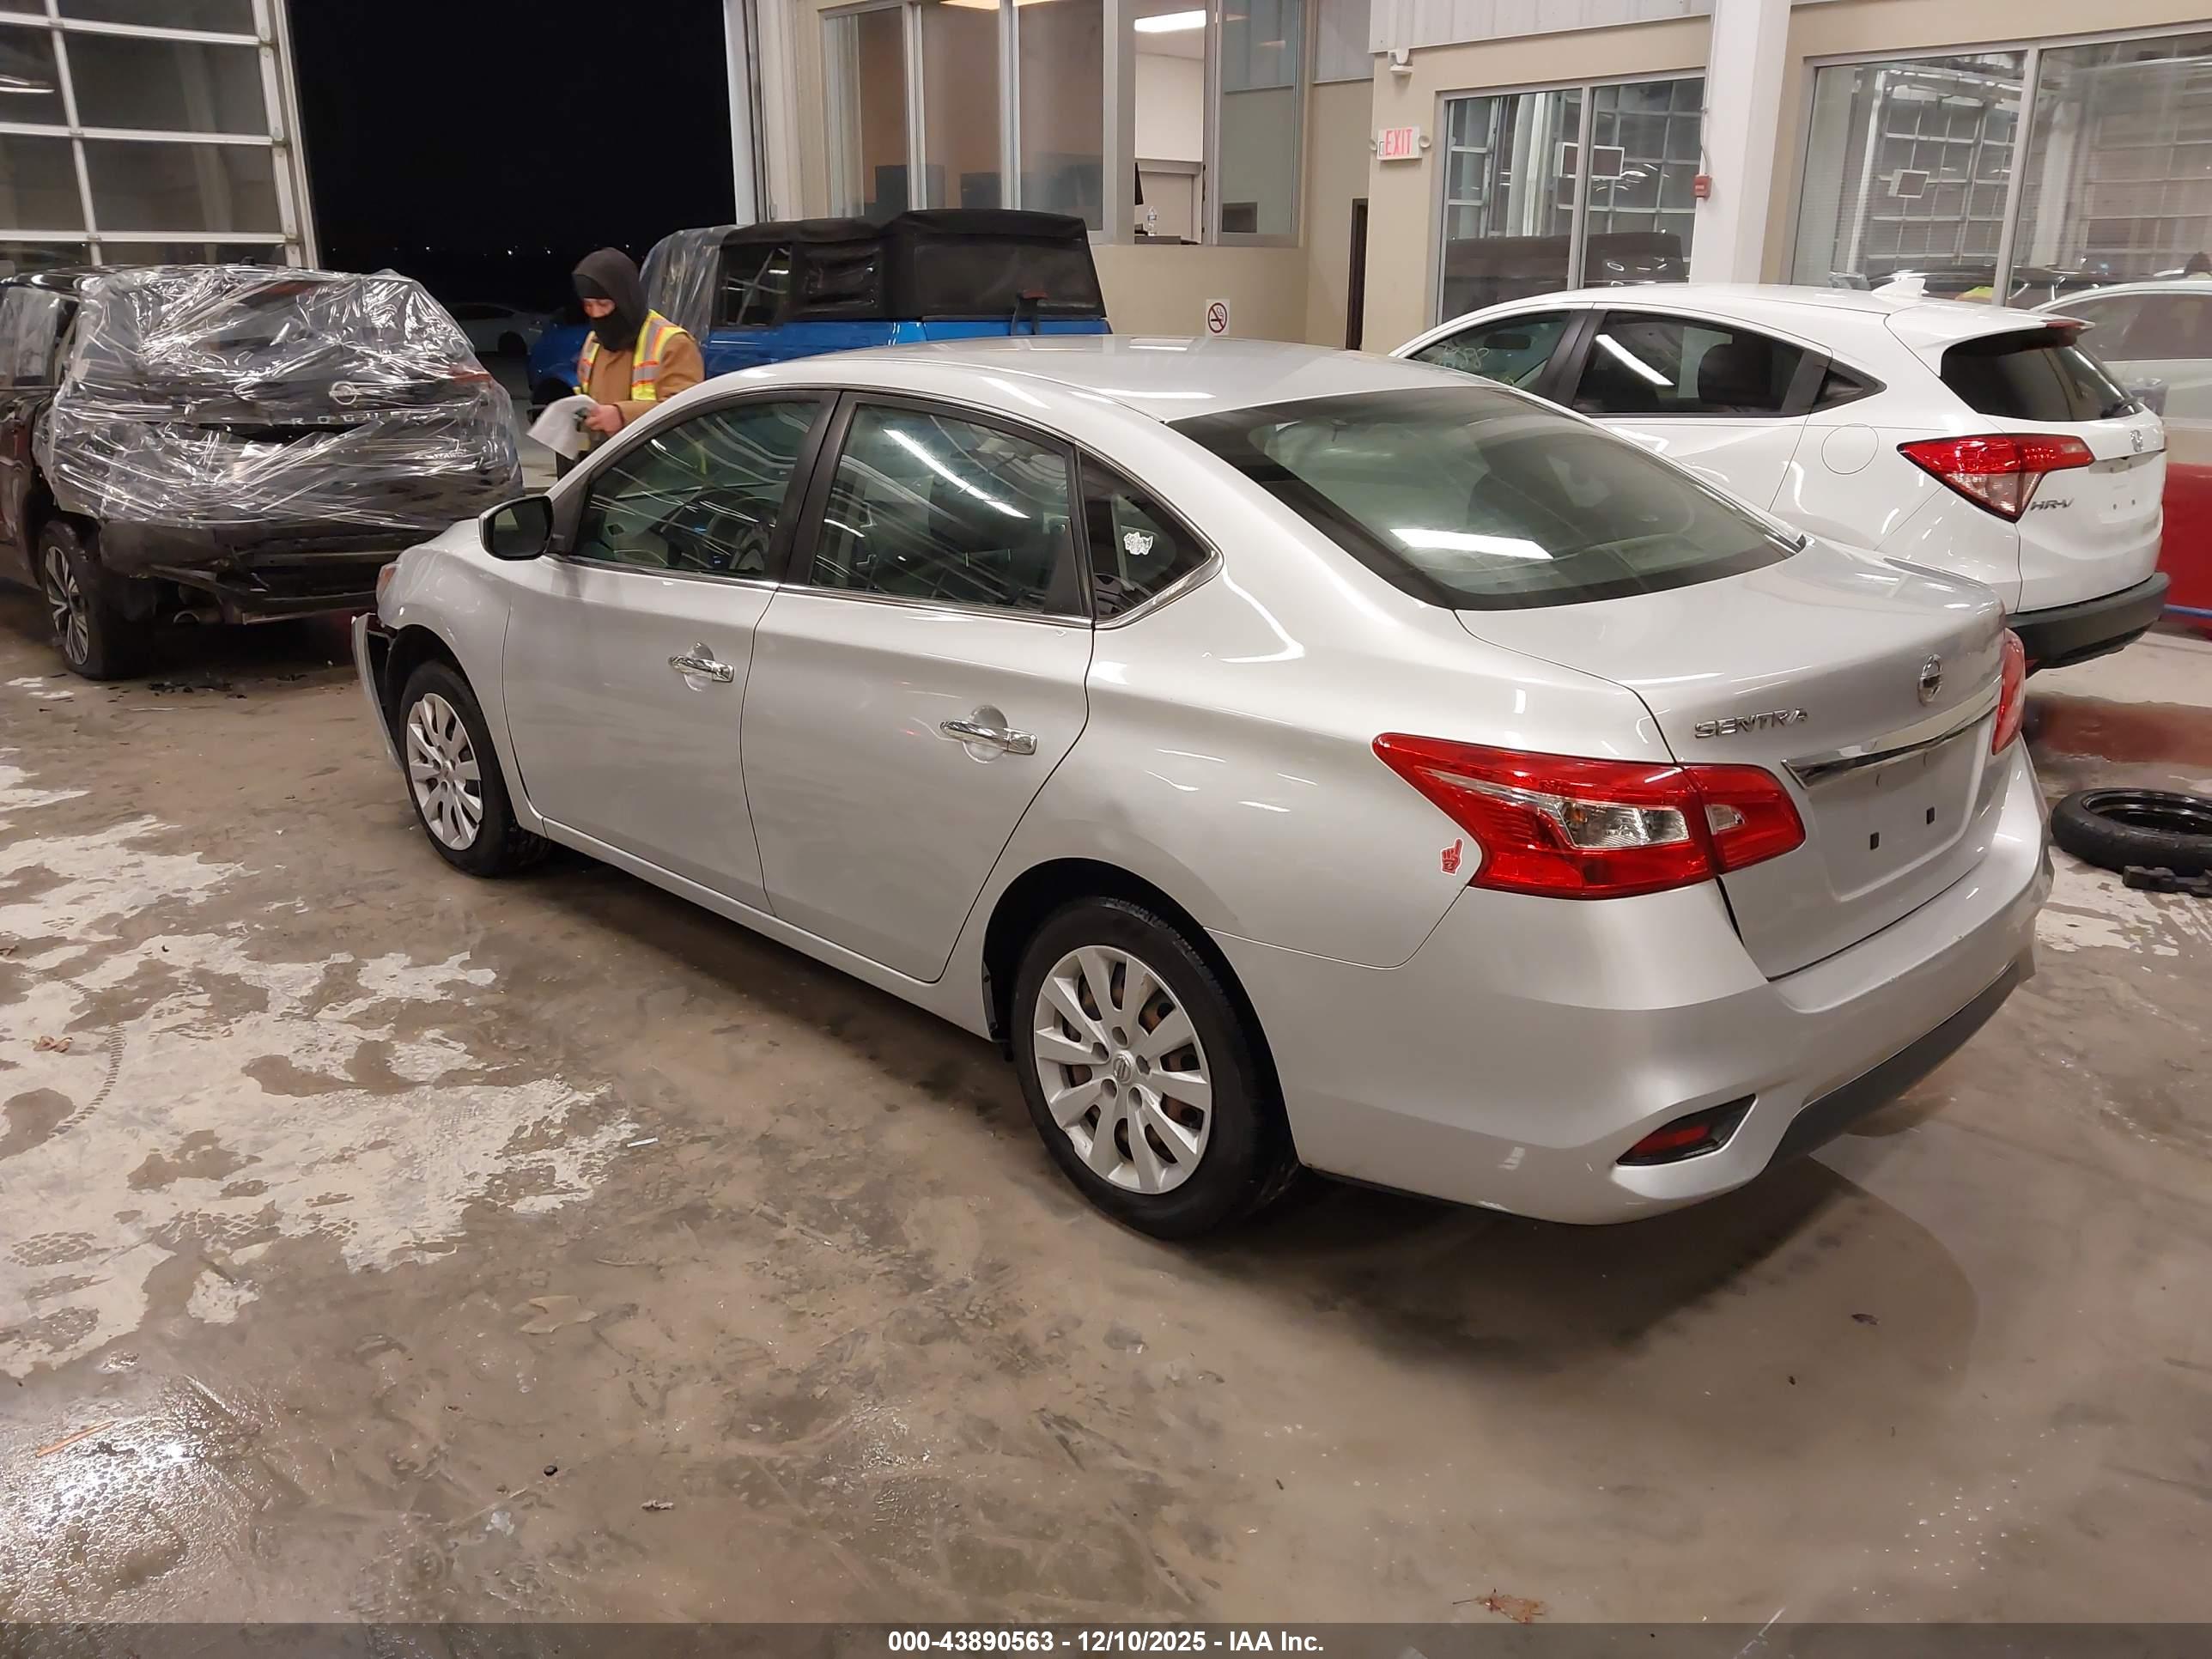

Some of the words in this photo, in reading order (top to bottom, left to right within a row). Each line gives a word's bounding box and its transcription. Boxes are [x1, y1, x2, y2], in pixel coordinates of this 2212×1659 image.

[1384, 128, 1413, 156] EXIT
[2030, 498, 2075, 512] HR-V
[1694, 707, 1808, 739] SENTRA
